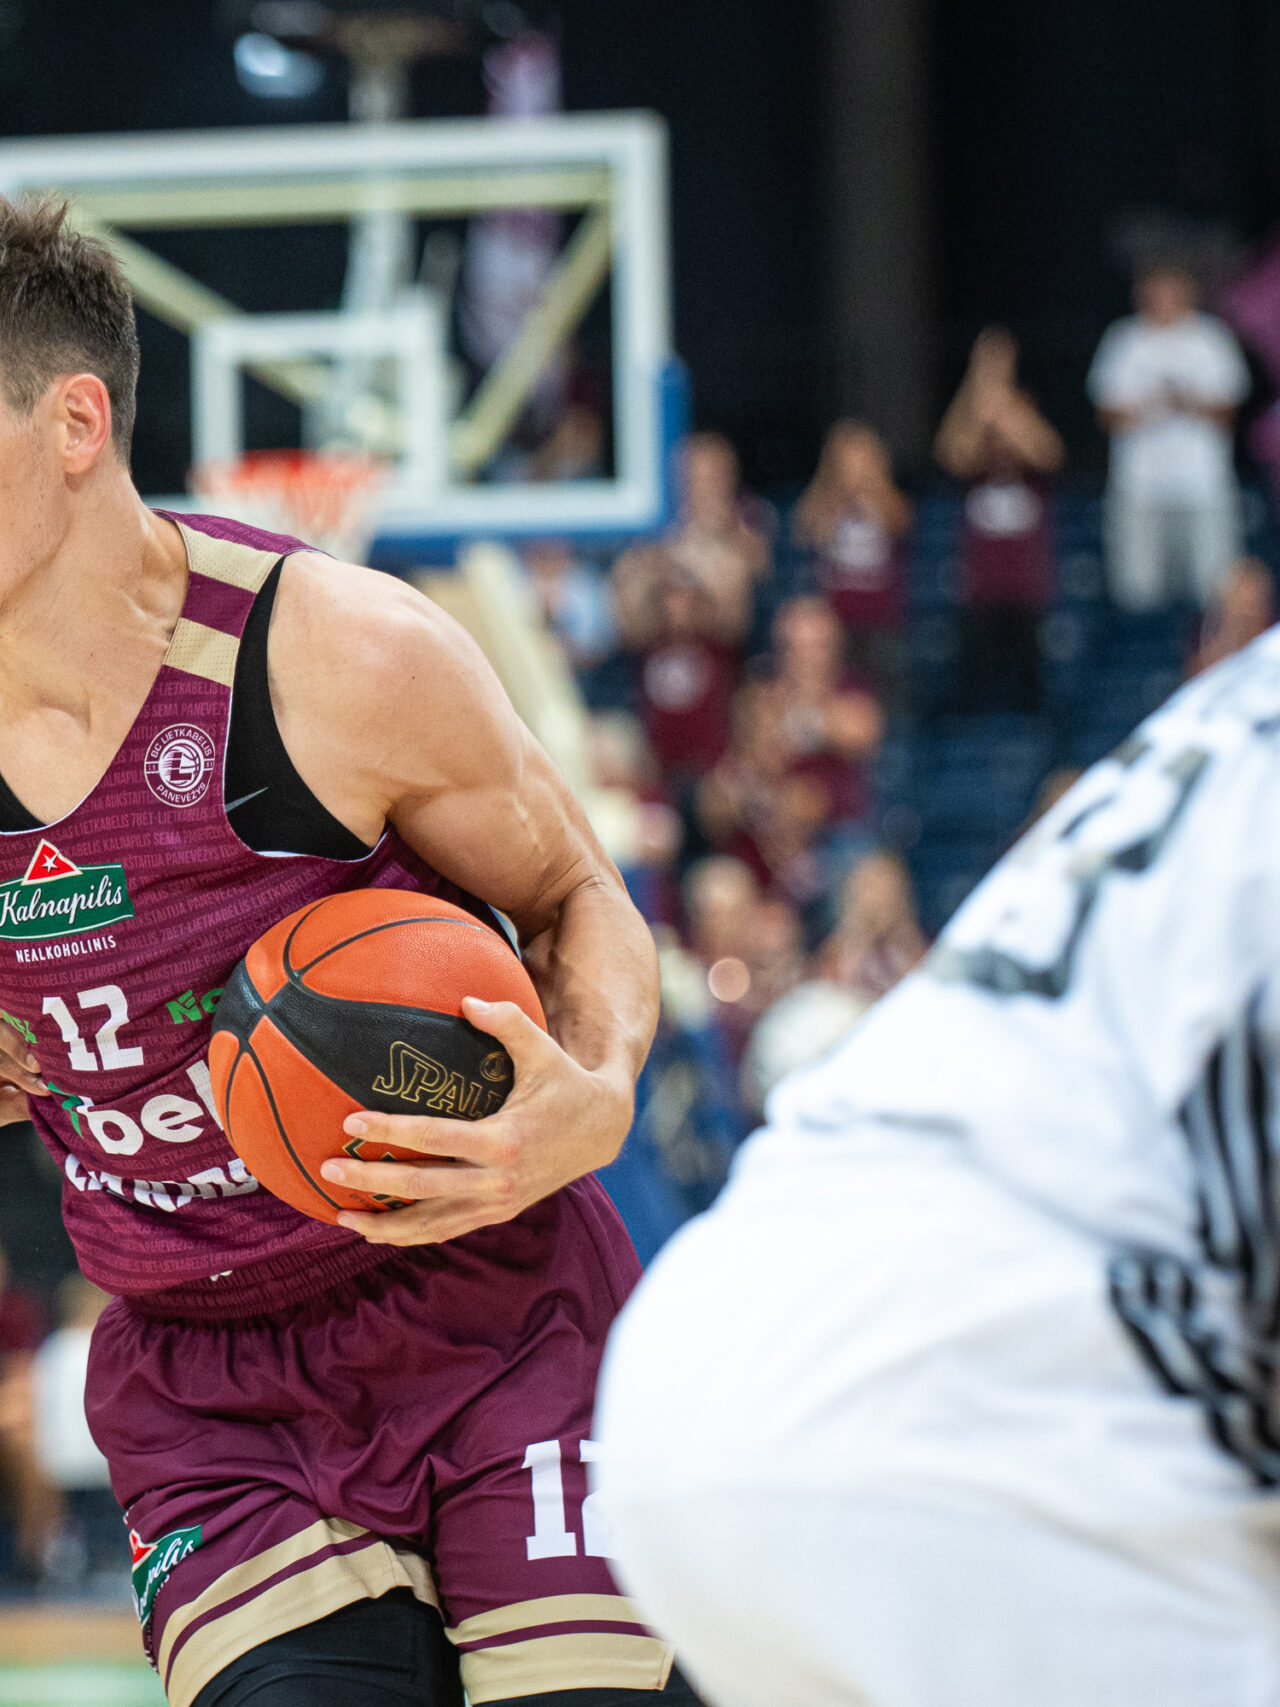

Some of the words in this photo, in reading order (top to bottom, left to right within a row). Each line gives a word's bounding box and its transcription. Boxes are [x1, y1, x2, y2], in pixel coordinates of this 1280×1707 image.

[162, 728, 212, 757] LIETKABELIS
[15, 935, 117, 963] NEALKOHOLINIS
[42, 984, 144, 1071] 12
